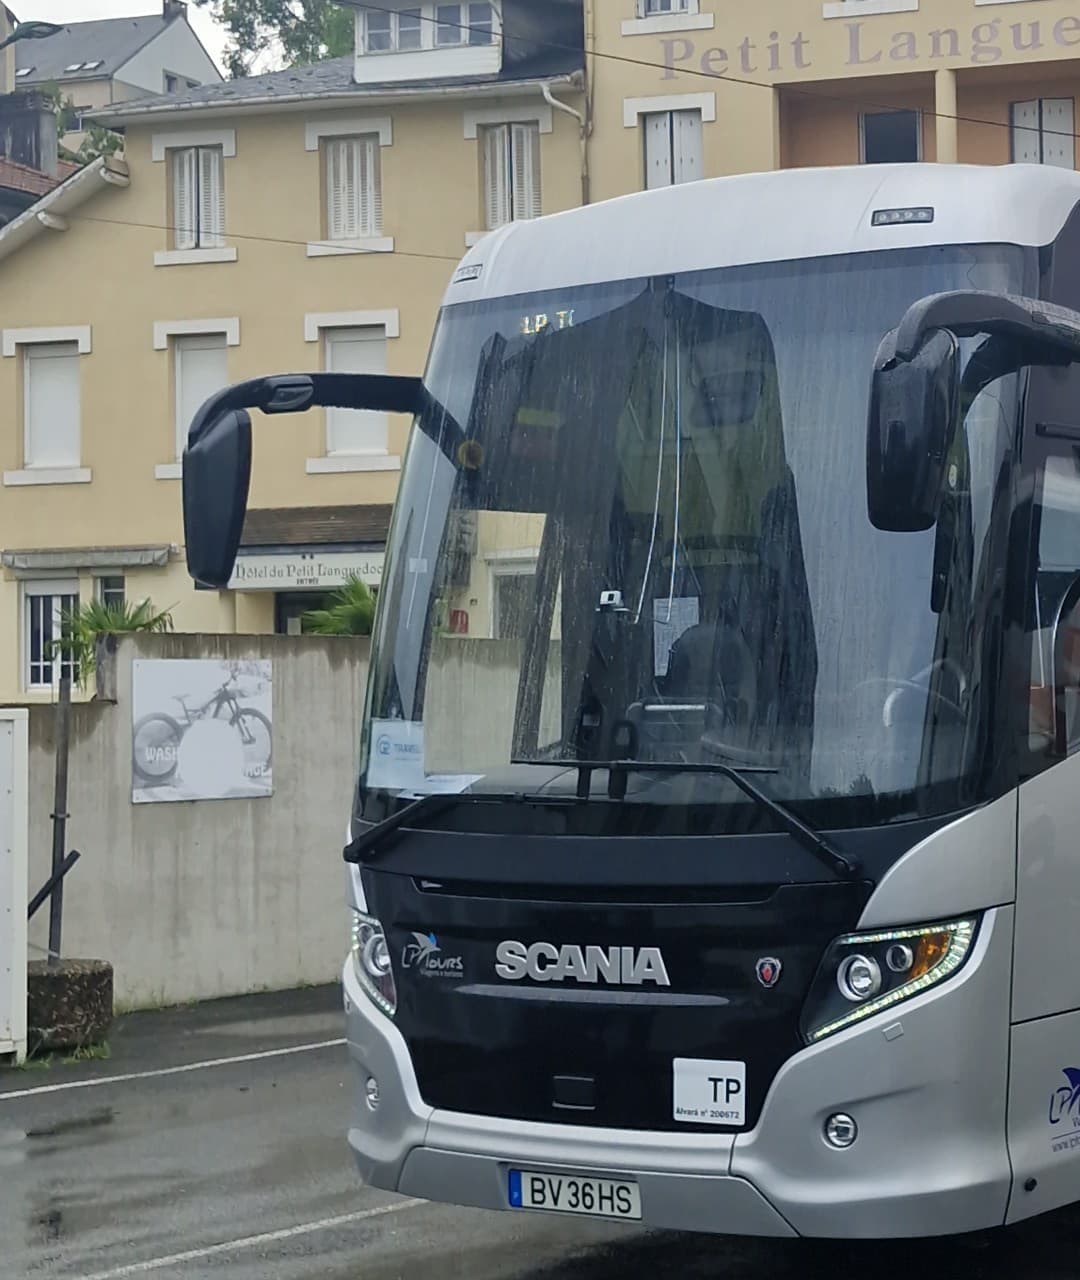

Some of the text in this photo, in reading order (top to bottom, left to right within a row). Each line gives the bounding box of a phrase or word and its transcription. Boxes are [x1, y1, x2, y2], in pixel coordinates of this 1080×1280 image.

[659, 31, 812, 81] Petit
[270, 564, 283, 578] du
[286, 564, 314, 578] Petit
[495, 940, 671, 986] SCANIA
[708, 1077, 741, 1104] TP
